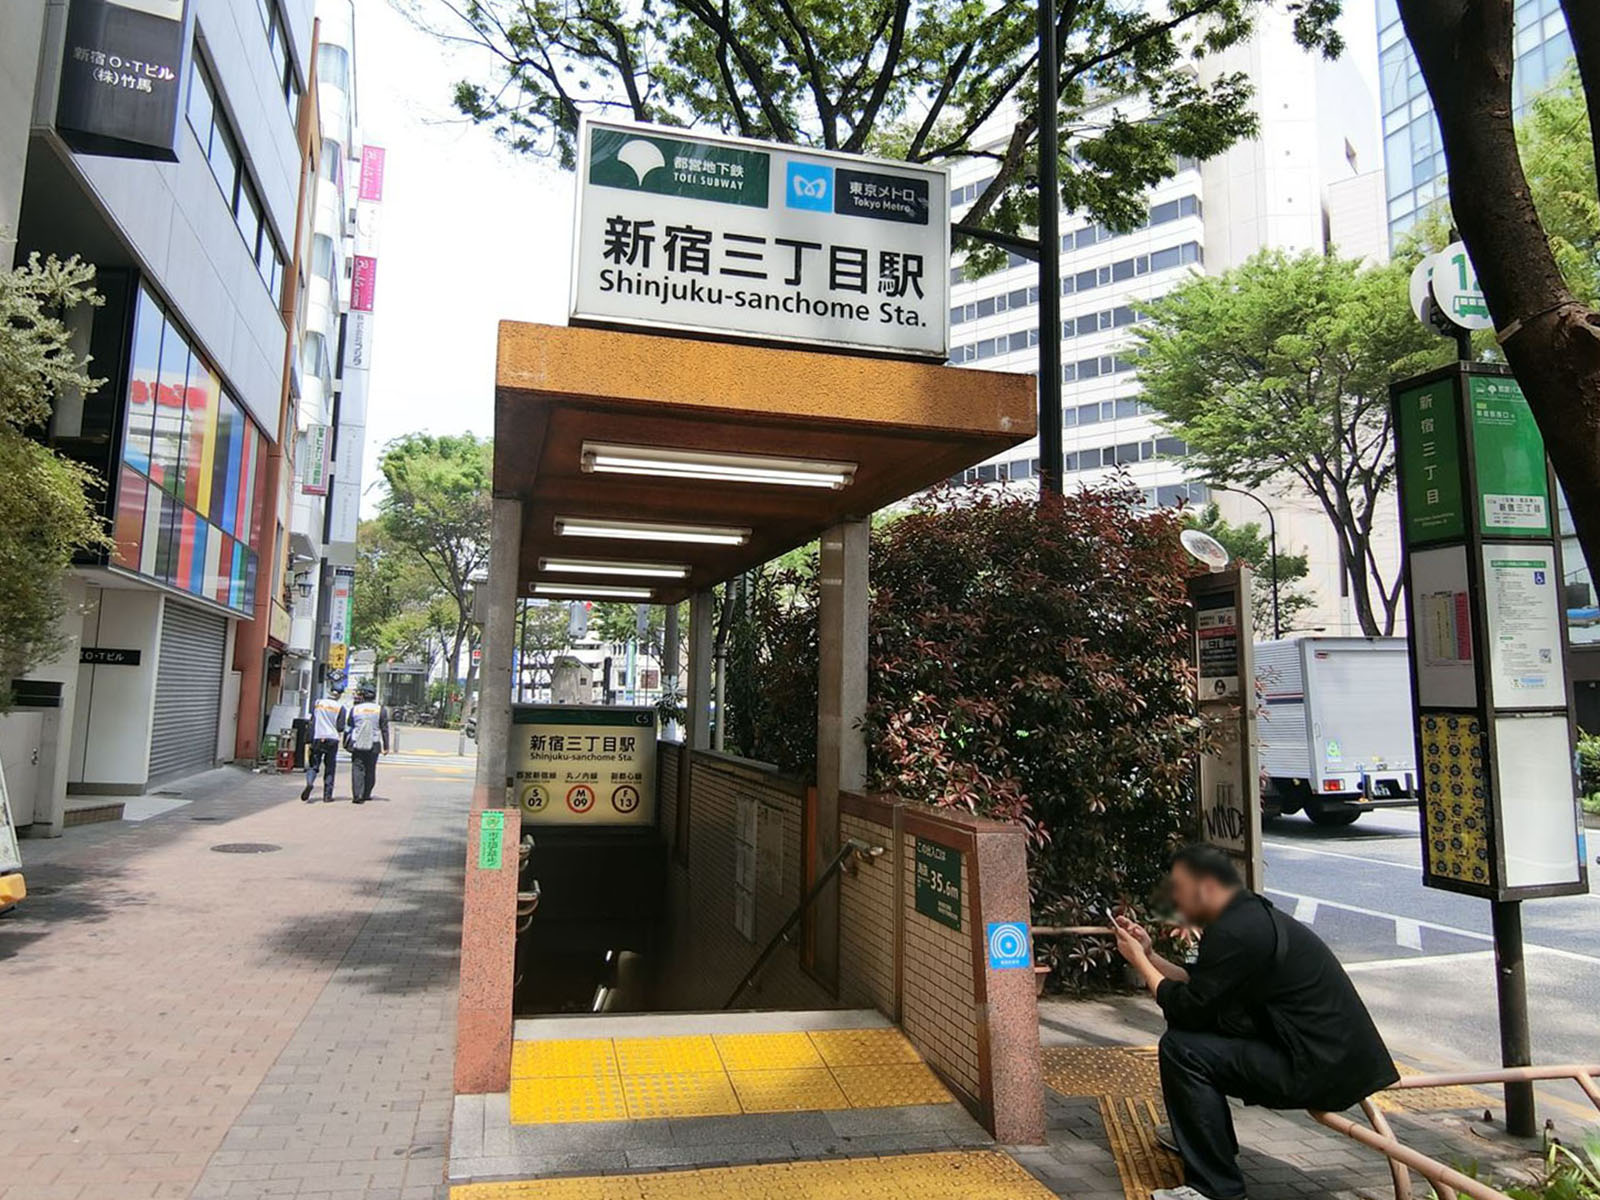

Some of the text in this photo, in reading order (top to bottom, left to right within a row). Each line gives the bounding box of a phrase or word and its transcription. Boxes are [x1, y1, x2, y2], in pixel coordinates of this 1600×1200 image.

[93, 67, 152, 93] (株)竹馬
[674, 156, 744, 178] 都営地下鉄
[673, 172, 744, 190] TOEI SUBWAY
[849, 181, 915, 201] 東京メトロ
[853, 196, 911, 213] Tokyo Metro
[603, 215, 924, 300] 新宿三丁目駅
[600, 268, 927, 327] Shinjuku-sanchome Sta.
[1419, 394, 1440, 504] 新宿三丁目
[530, 735, 636, 752] 新宿三丁目駅
[530, 752, 634, 762] Shinjuku-sanchome Sta.
[533, 789, 539, 797] S
[527, 798, 542, 807] 02
[573, 798, 588, 807] 09
[620, 798, 633, 807] 13
